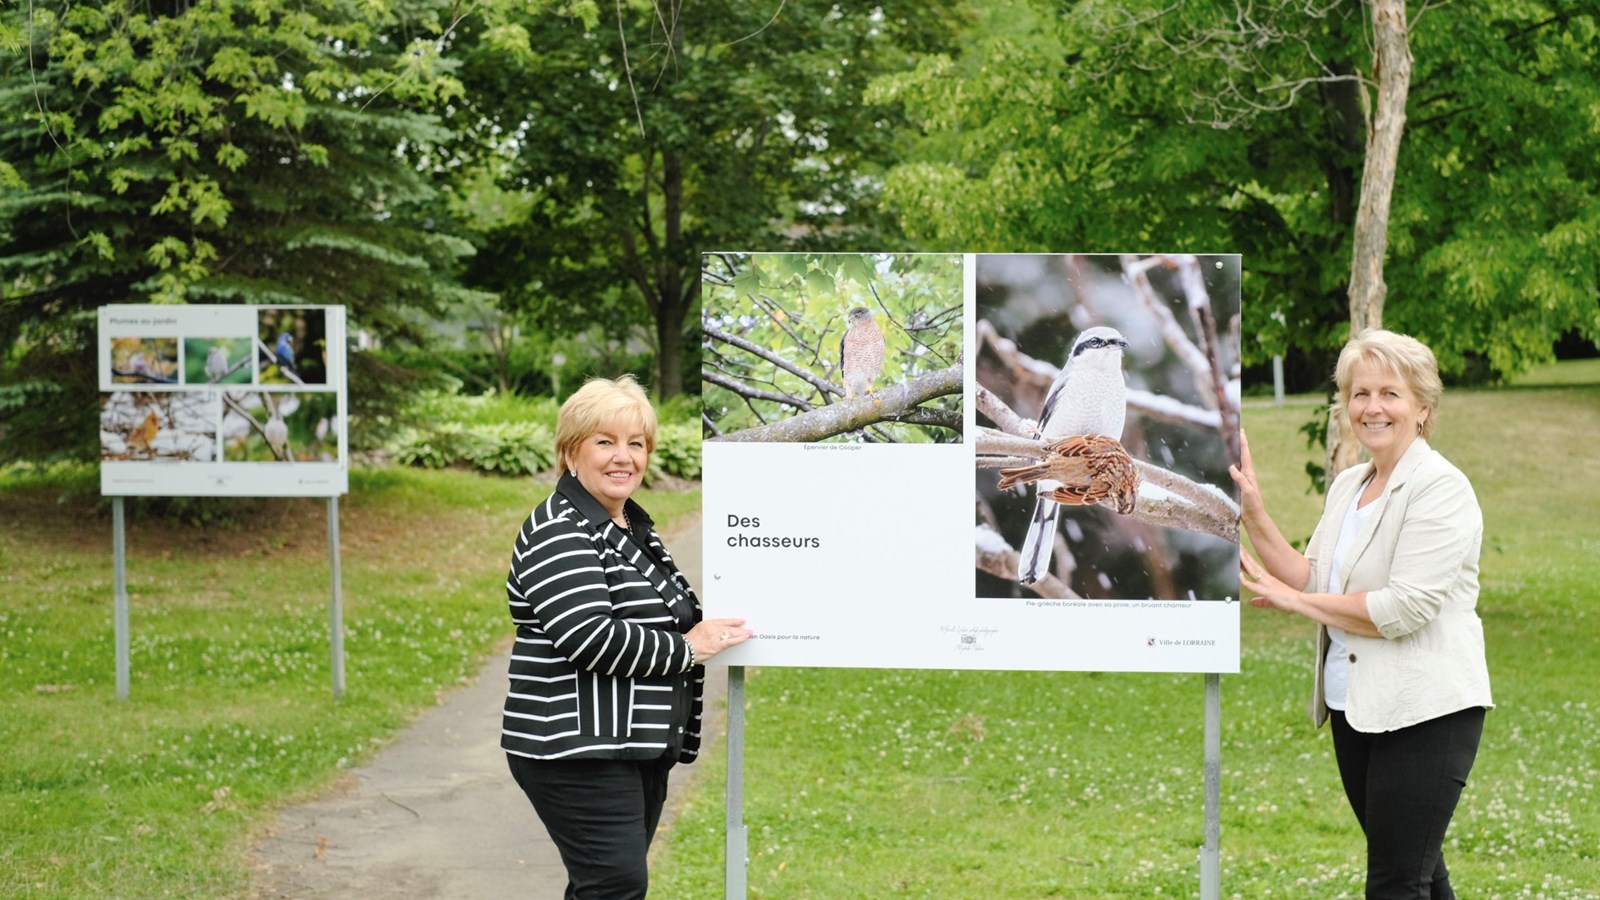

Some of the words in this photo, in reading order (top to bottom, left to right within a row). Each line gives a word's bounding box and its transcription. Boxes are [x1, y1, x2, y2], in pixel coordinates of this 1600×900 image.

[803, 443, 828, 451] Épervier
[727, 514, 760, 528] Des
[727, 533, 820, 548] chasseurs
